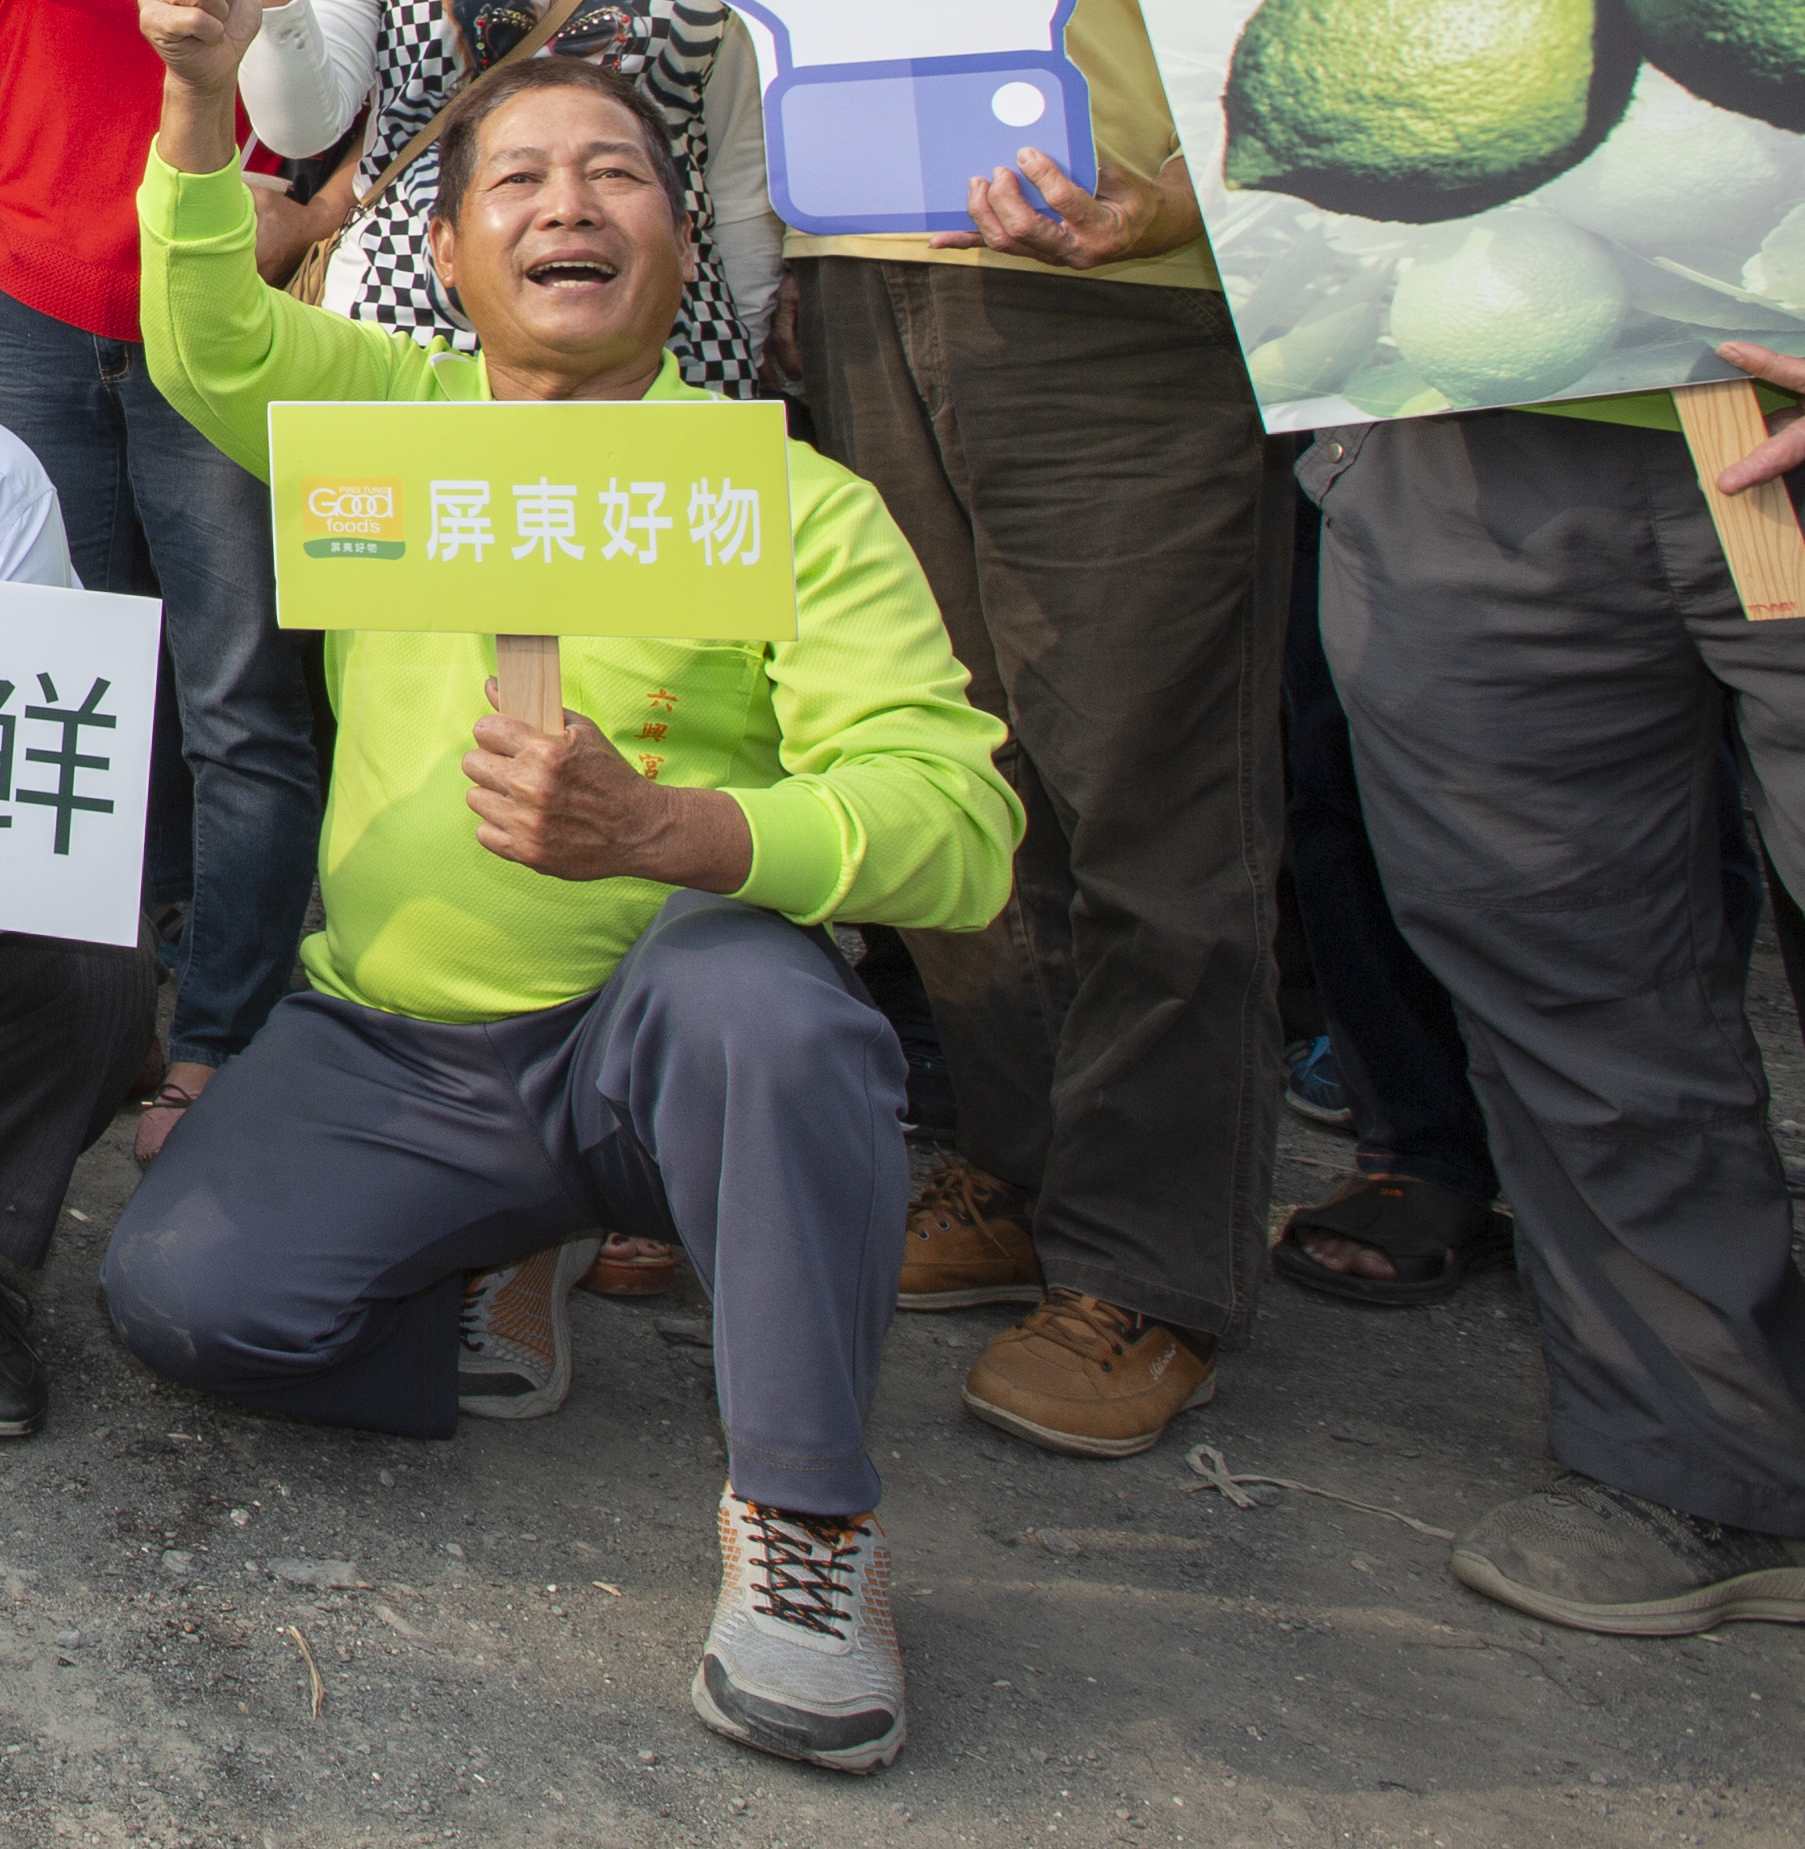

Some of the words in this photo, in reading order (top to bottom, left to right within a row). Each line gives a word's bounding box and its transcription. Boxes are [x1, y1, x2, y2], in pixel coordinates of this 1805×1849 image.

[308, 486, 394, 518] Good
[326, 517, 381, 534] food's
[426, 476, 761, 566] 屏東好物
